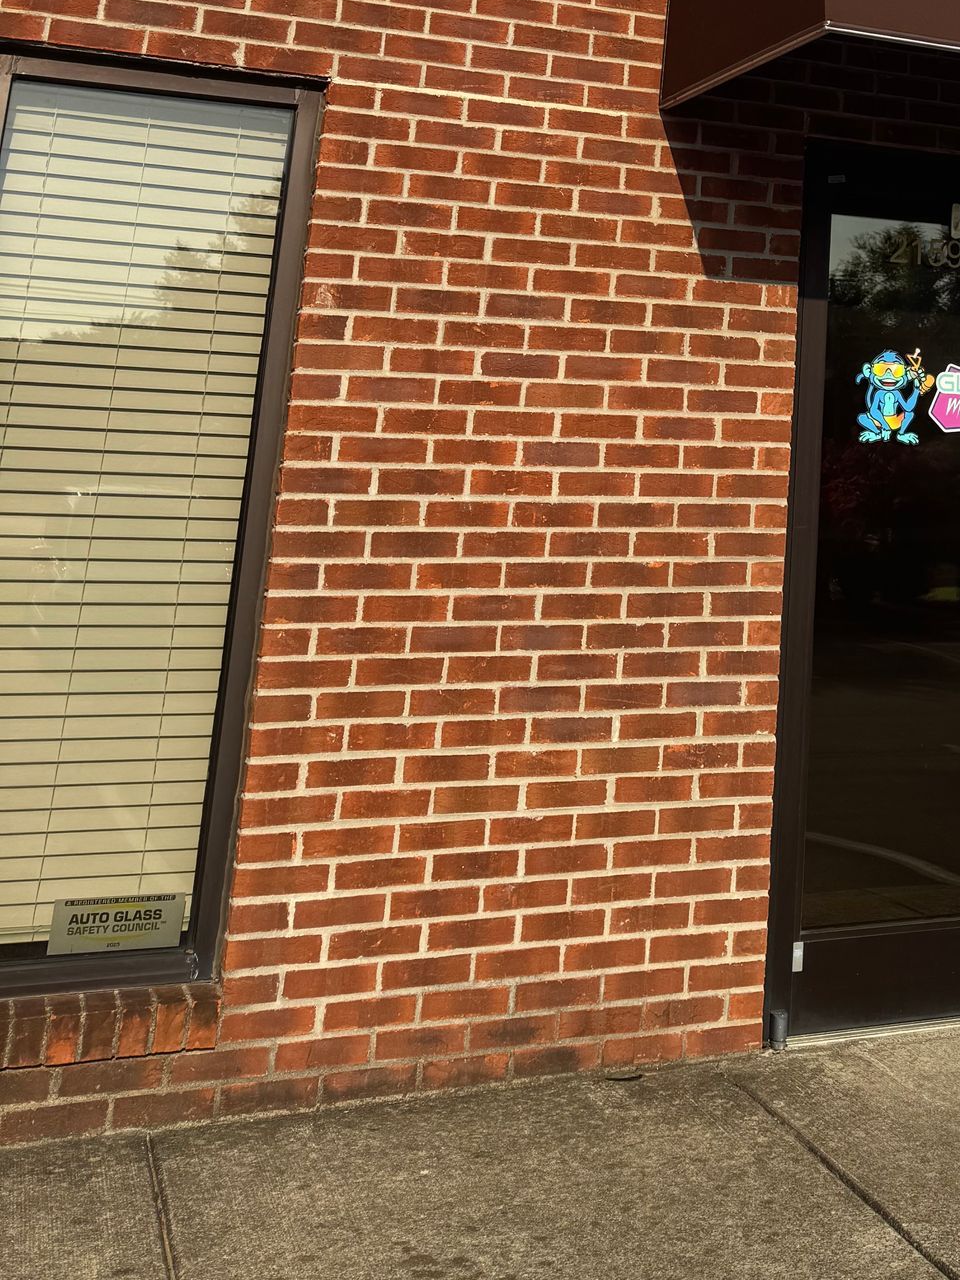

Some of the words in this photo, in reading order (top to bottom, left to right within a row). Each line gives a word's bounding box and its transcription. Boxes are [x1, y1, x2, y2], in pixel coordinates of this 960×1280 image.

[68, 912, 110, 926] AUTO
[113, 909, 162, 923] GLASS
[66, 924, 110, 936] SAFETY
